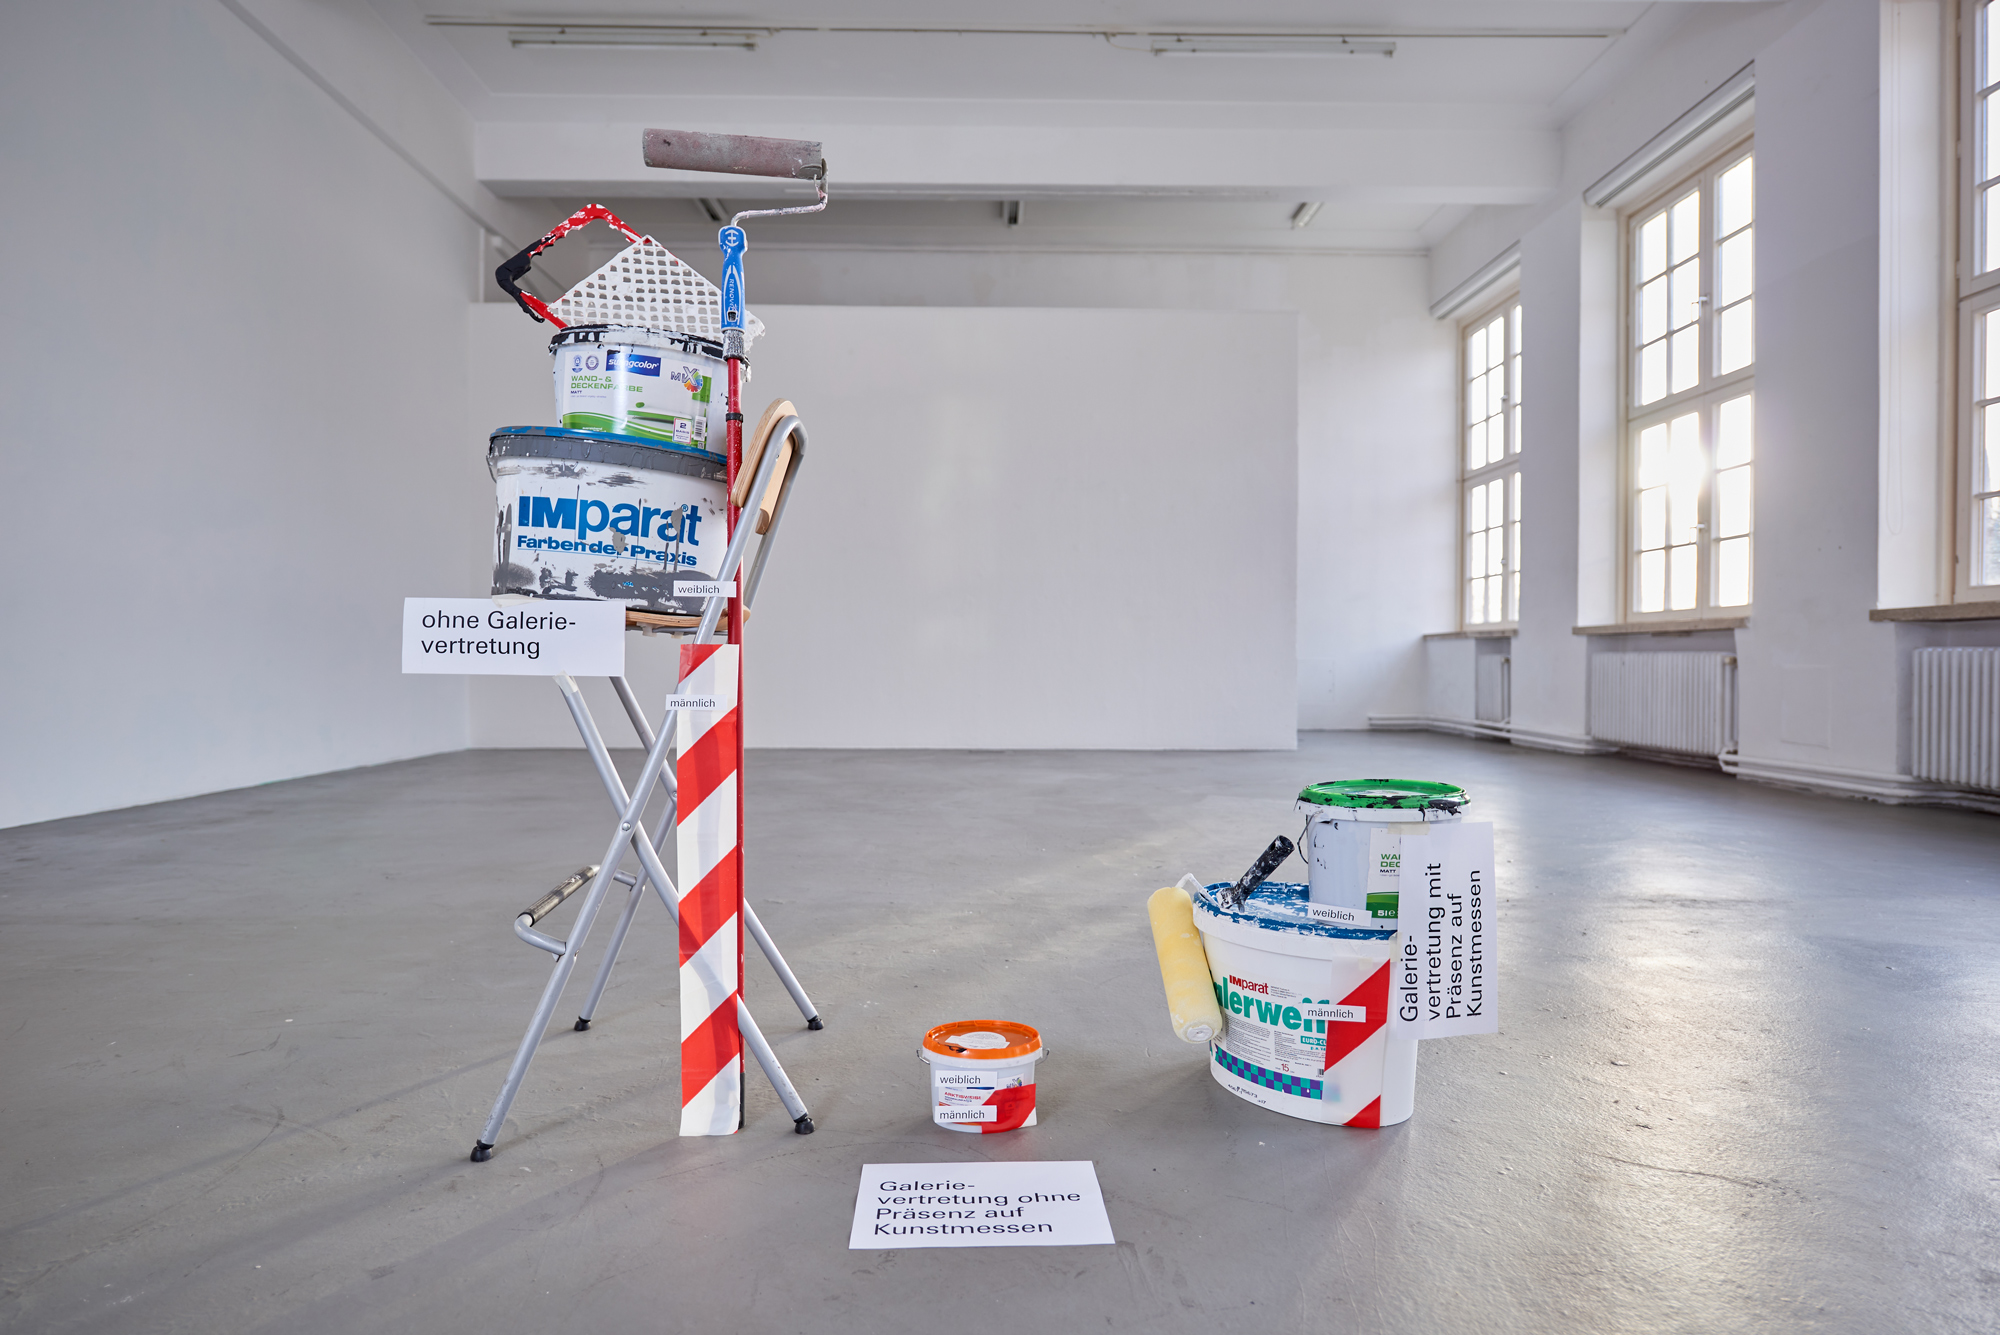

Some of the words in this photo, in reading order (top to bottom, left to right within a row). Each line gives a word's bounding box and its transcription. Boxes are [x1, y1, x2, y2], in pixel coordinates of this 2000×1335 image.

[608, 358, 658, 370] swngcolor
[571, 382, 643, 393] DECKENFABE
[517, 535, 587, 552] Farben
[630, 544, 697, 566] Praxis
[678, 585, 720, 594] weiblich
[422, 610, 479, 628] ohne
[487, 610, 576, 630] Galerie-
[421, 637, 540, 659] vertretung
[670, 699, 716, 707] männlich
[1424, 863, 1441, 897] mit
[1312, 908, 1355, 921] weiblich
[1447, 893, 1462, 927] auf
[1466, 870, 1482, 1017] Kunstmessen
[1426, 907, 1445, 1021] vertretung
[1399, 935, 1418, 1021] Galerie-
[1446, 935, 1462, 1018] Präsenz
[1229, 975, 1269, 994] IMparat
[1307, 1008, 1354, 1019] männlich
[1281, 1063, 1289, 1072] 15
[940, 1075, 981, 1084] weiblich
[939, 1110, 985, 1119] männlich
[879, 1180, 976, 1192] Galerie-
[877, 1194, 1008, 1206] vertretung
[1017, 1192, 1081, 1204] ohne
[876, 1207, 976, 1220] Präsenz
[985, 1207, 1025, 1218] auf
[874, 1222, 1053, 1236] Kunstmessen
